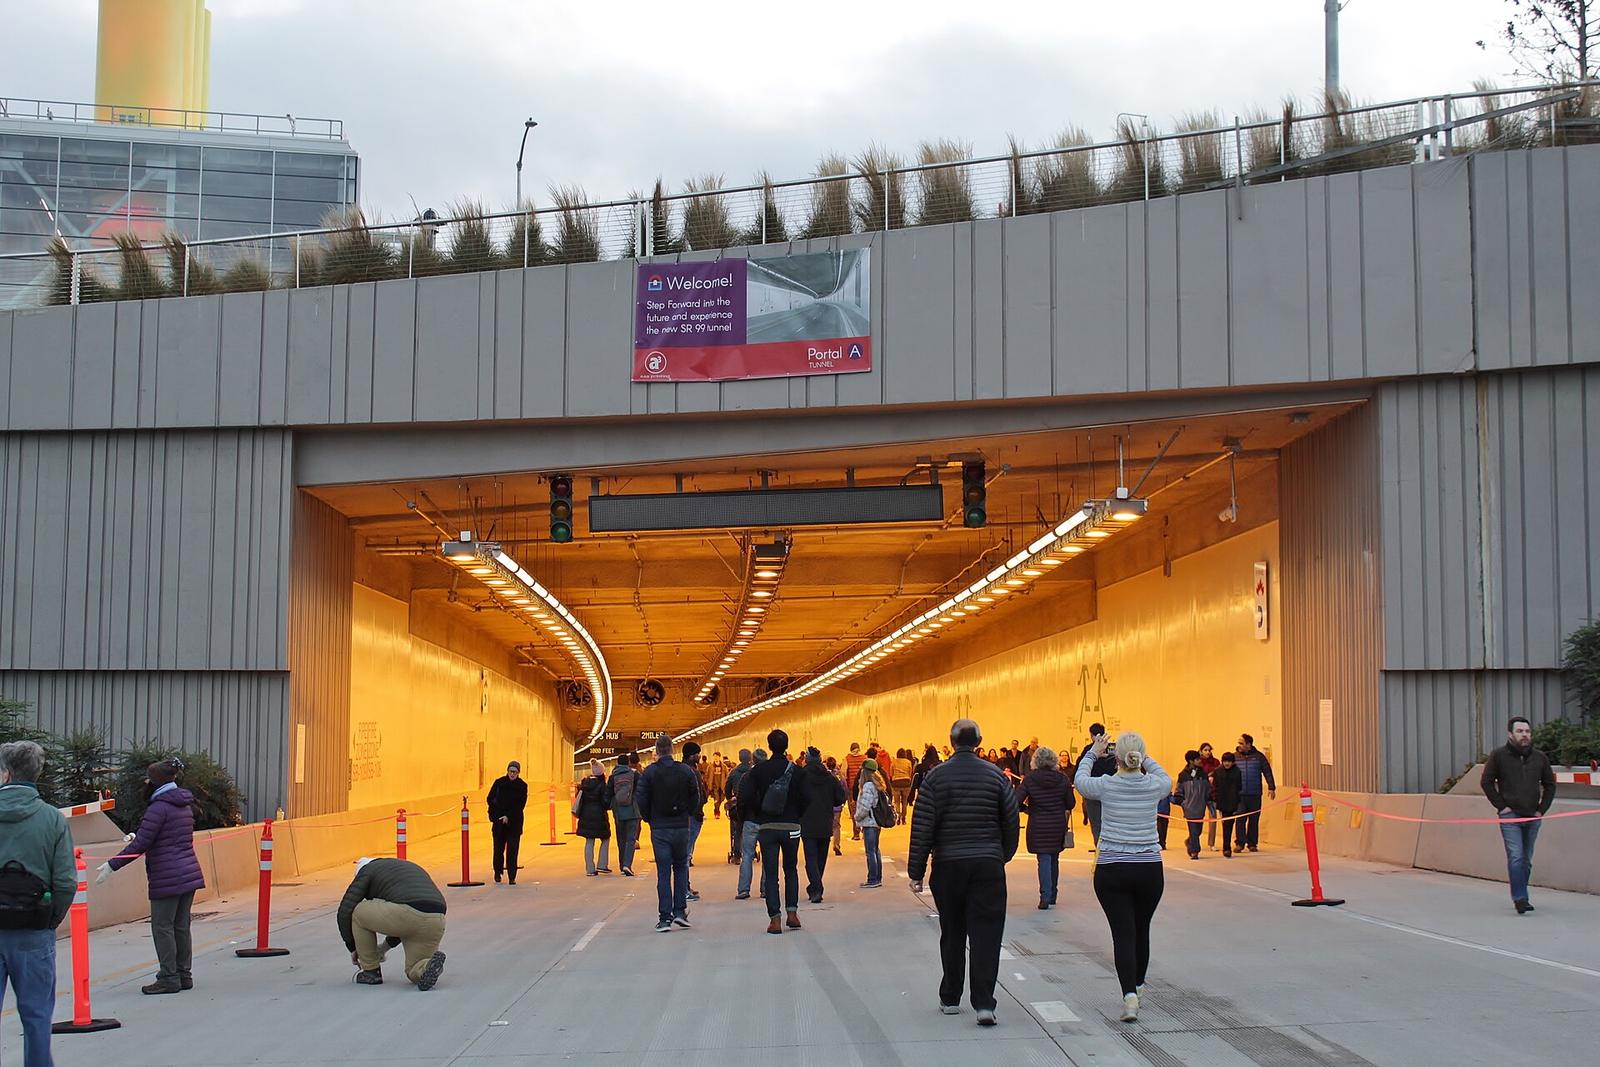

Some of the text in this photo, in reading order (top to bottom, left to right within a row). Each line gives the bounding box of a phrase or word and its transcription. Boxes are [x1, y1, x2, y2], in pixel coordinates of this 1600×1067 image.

[666, 273, 733, 291] Welcome!
[646, 296, 731, 311] Step Forward into the
[646, 311, 733, 322] future and experience
[646, 322, 732, 335] the new SR 99 tunnel
[808, 345, 861, 360] Portal A
